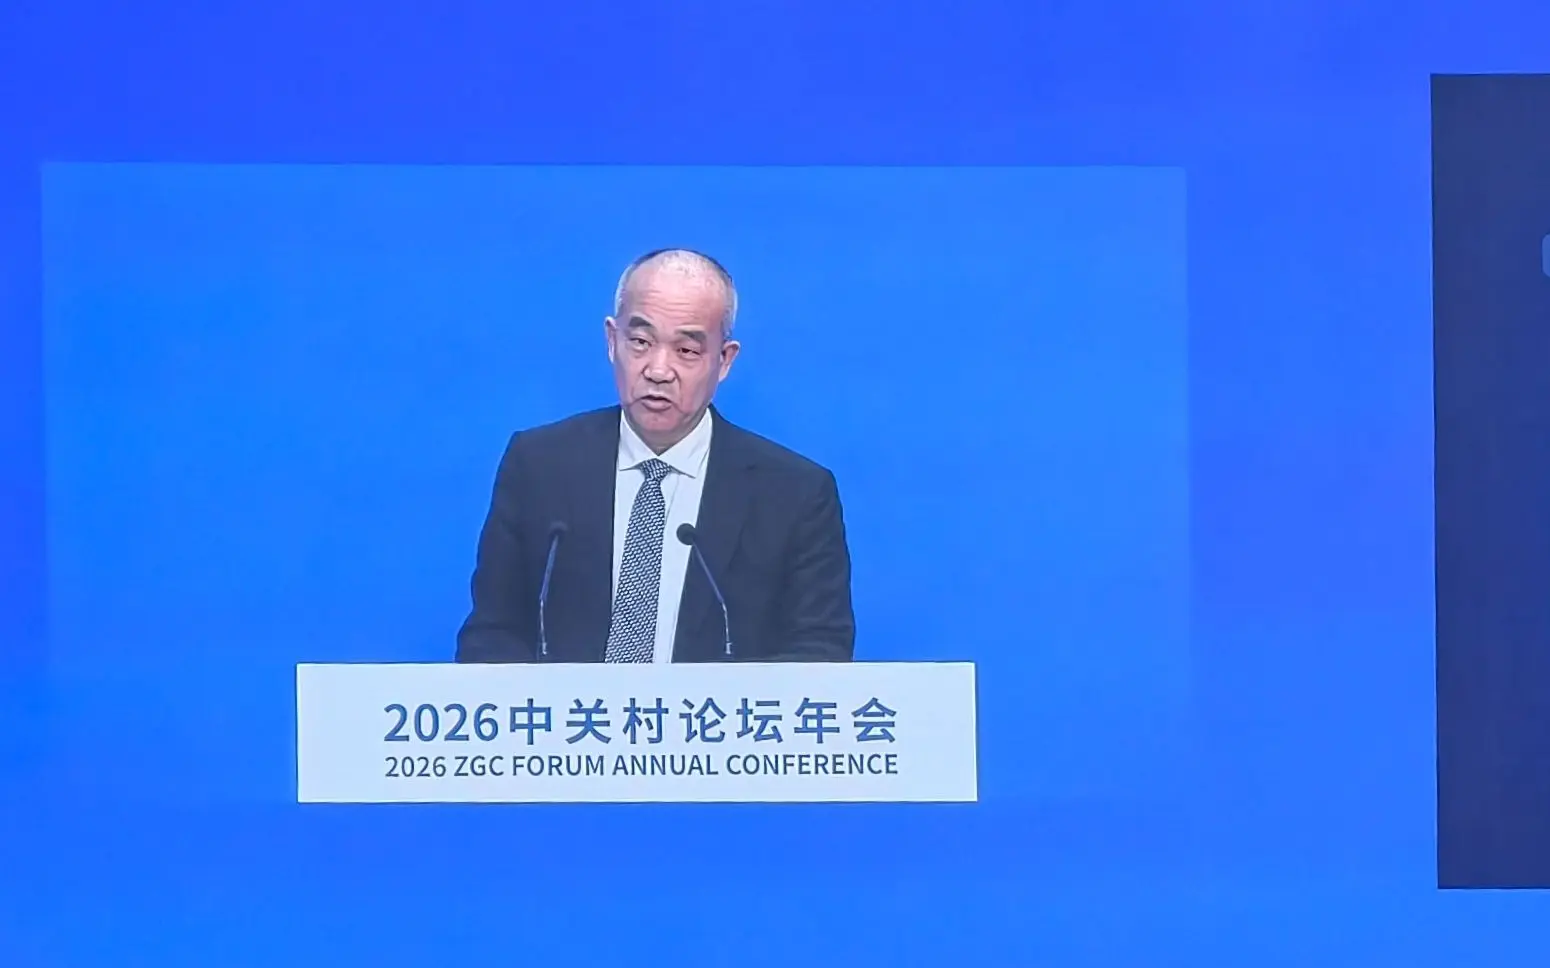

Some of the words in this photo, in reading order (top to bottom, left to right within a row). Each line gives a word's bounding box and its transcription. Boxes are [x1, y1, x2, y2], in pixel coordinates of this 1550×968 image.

[383, 697, 897, 745] 2026中关村论坛年会
[385, 756, 446, 778] 2026
[453, 755, 504, 778] ZGC
[512, 754, 605, 777] FORUM
[612, 753, 719, 777] ANNUAL
[726, 753, 898, 776] CONFERENCE
